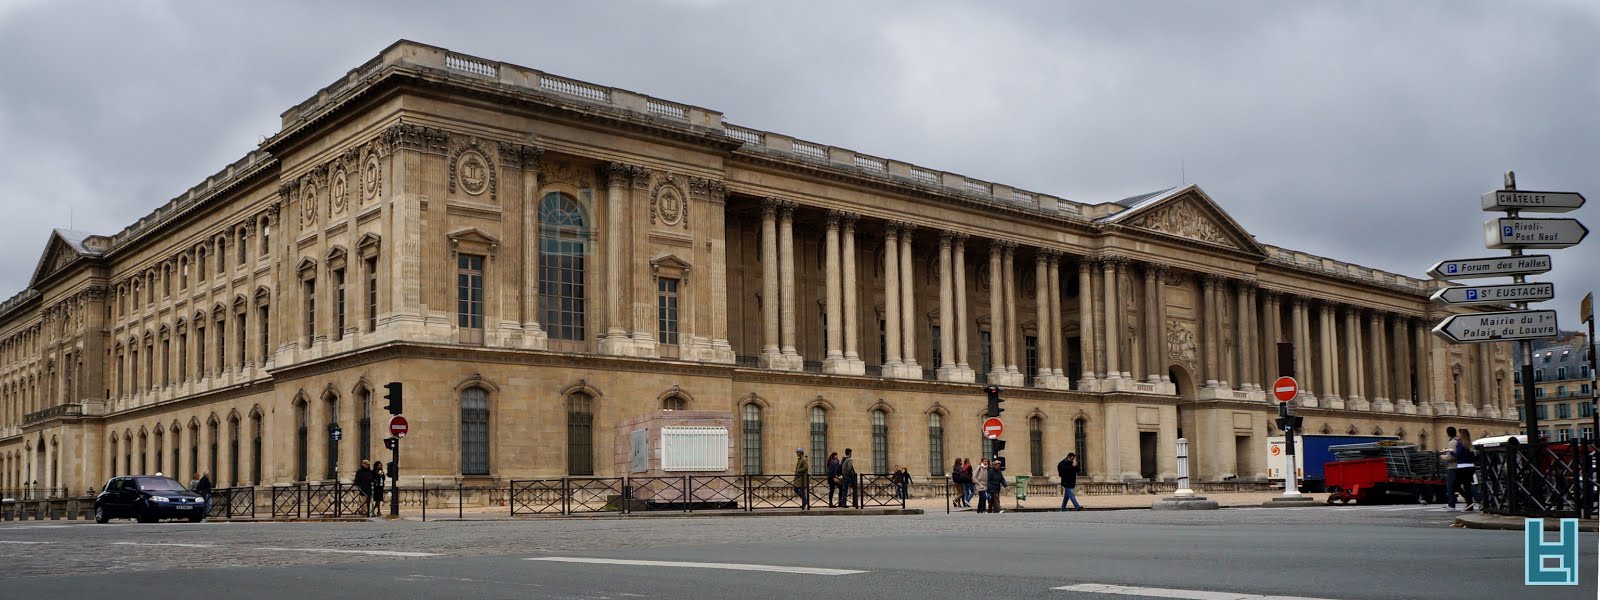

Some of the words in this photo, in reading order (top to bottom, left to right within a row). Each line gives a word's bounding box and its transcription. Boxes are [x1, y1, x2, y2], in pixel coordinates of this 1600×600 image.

[1500, 194, 1546, 204] CHÂTELET
[1514, 222, 1543, 231] Rivoli-
[1515, 233, 1535, 241] Pont
[1538, 233, 1559, 241] Neuf
[1461, 263, 1490, 272] Forum
[1496, 261, 1513, 270] des
[1518, 259, 1547, 269] Halles
[1467, 290, 1476, 299] P
[1496, 286, 1550, 297] EUSTACHE
[1480, 317, 1515, 326] Mairie
[1521, 316, 1533, 324] du
[1463, 329, 1496, 337] Palais
[1502, 328, 1515, 336] du
[1519, 324, 1554, 335] Louvre
